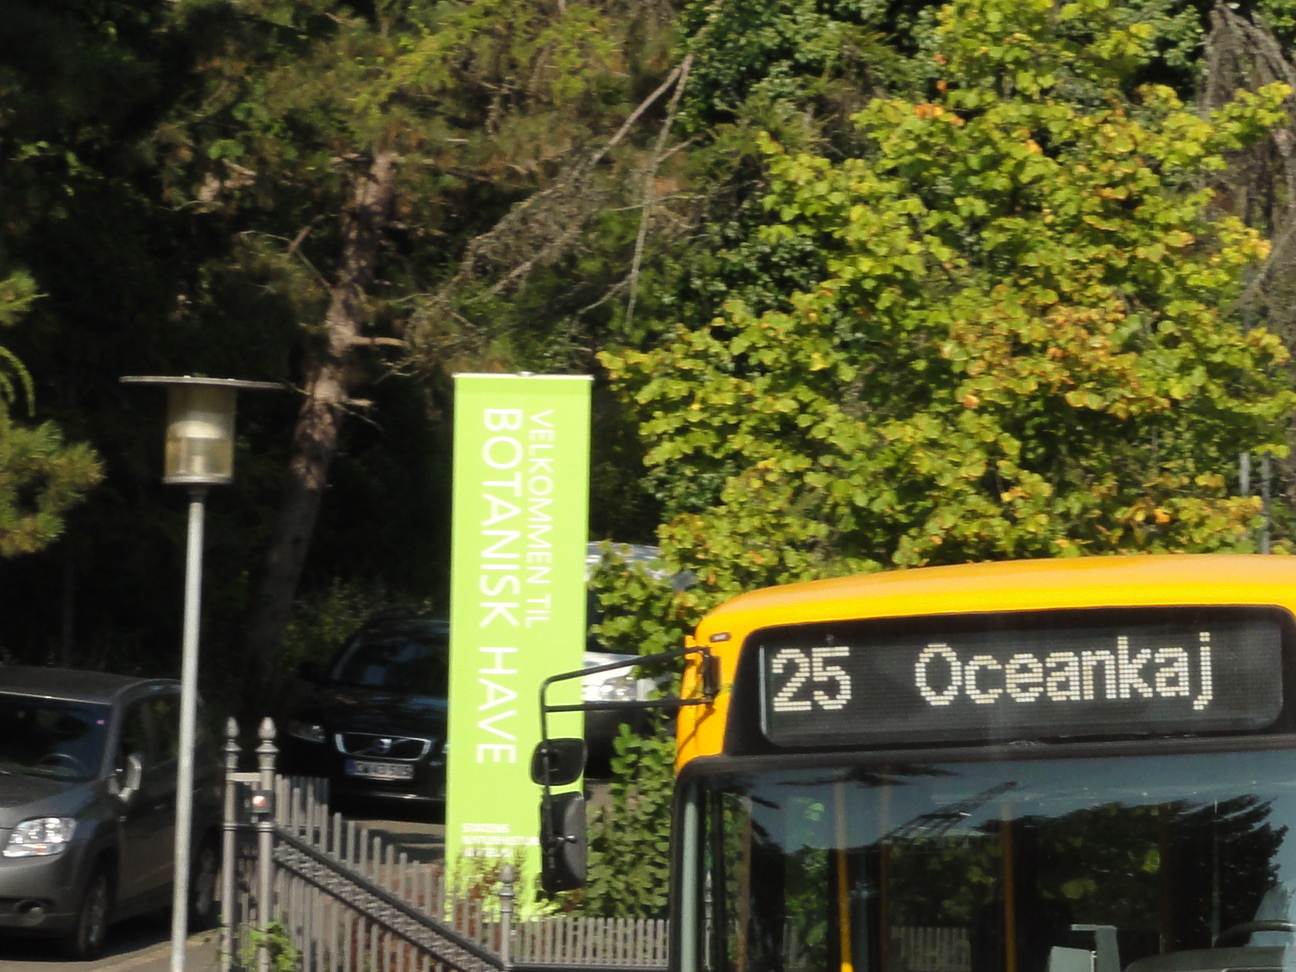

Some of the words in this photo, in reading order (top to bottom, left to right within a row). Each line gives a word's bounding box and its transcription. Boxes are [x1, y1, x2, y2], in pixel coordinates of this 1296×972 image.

[479, 408, 524, 628] BOTANISK
[525, 409, 556, 584] VELKOMMEN
[525, 593, 552, 629] TIL
[476, 647, 519, 764] HAVE
[771, 646, 852, 712] 25
[914, 631, 1213, 711] Oceankaj
